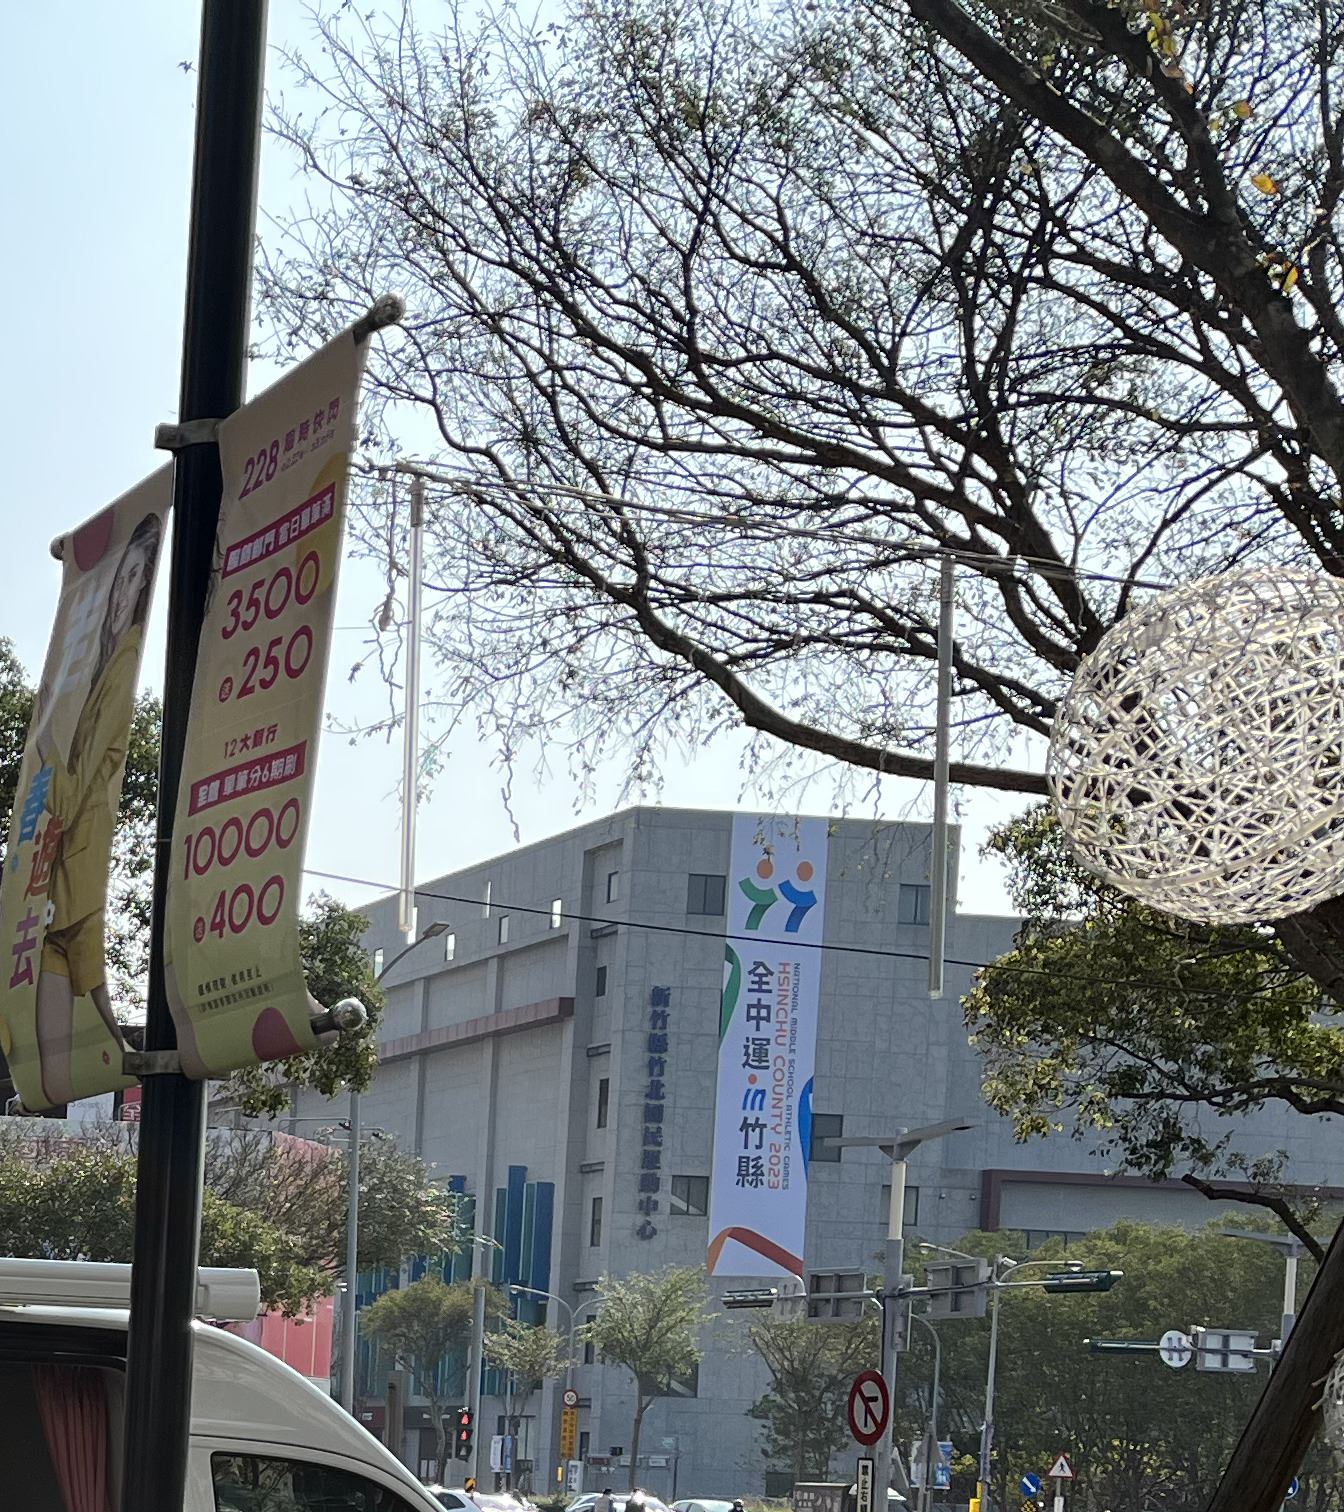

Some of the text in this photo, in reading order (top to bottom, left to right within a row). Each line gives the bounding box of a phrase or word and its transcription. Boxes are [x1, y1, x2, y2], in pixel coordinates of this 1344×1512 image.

[239, 440, 280, 500] 228
[221, 550, 320, 640] 3500
[236, 624, 313, 700] 250
[183, 797, 300, 881] 10000
[210, 875, 285, 939] 400
[768, 962, 791, 1190] HSINCHU COUNTY 2023
